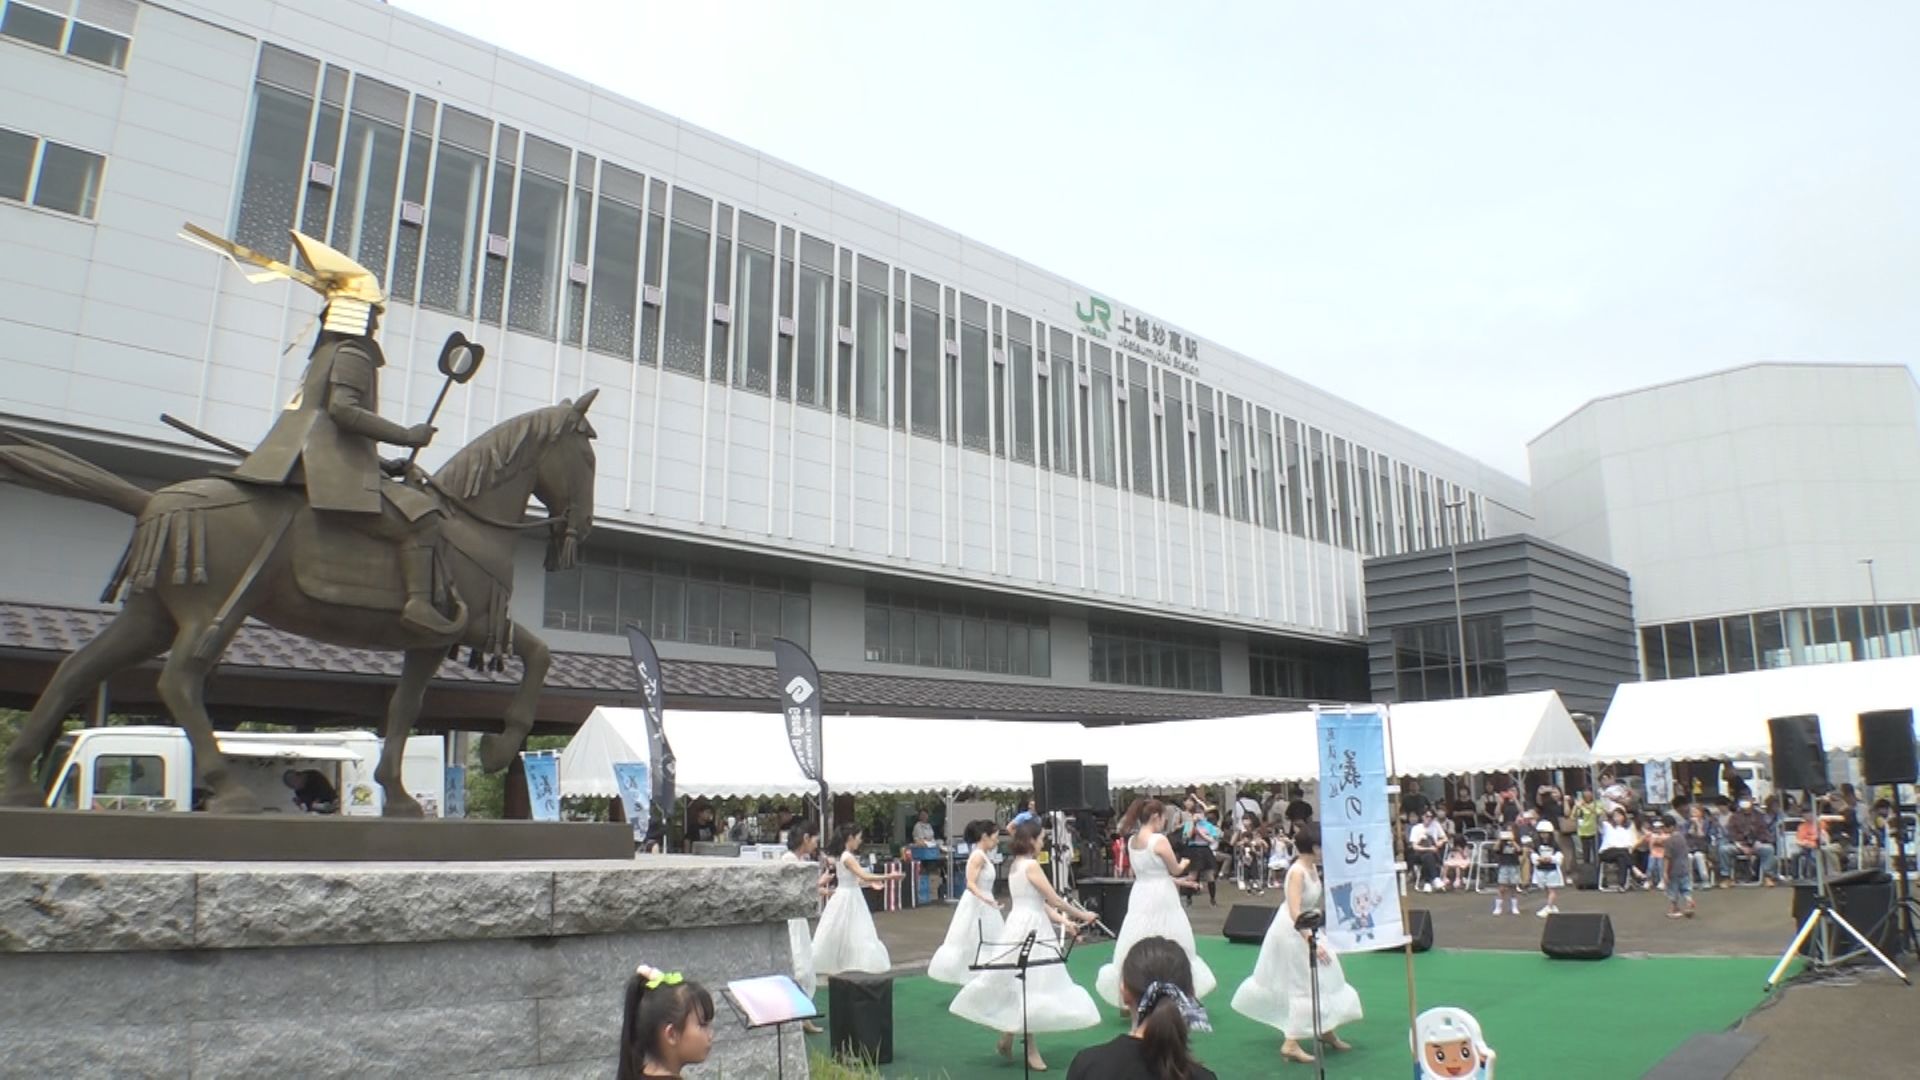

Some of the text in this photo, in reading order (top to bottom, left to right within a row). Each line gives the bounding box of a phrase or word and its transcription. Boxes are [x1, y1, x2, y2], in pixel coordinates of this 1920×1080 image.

[1076, 296, 1111, 332] JR
[1118, 310, 1198, 361] 上越妙高駅
